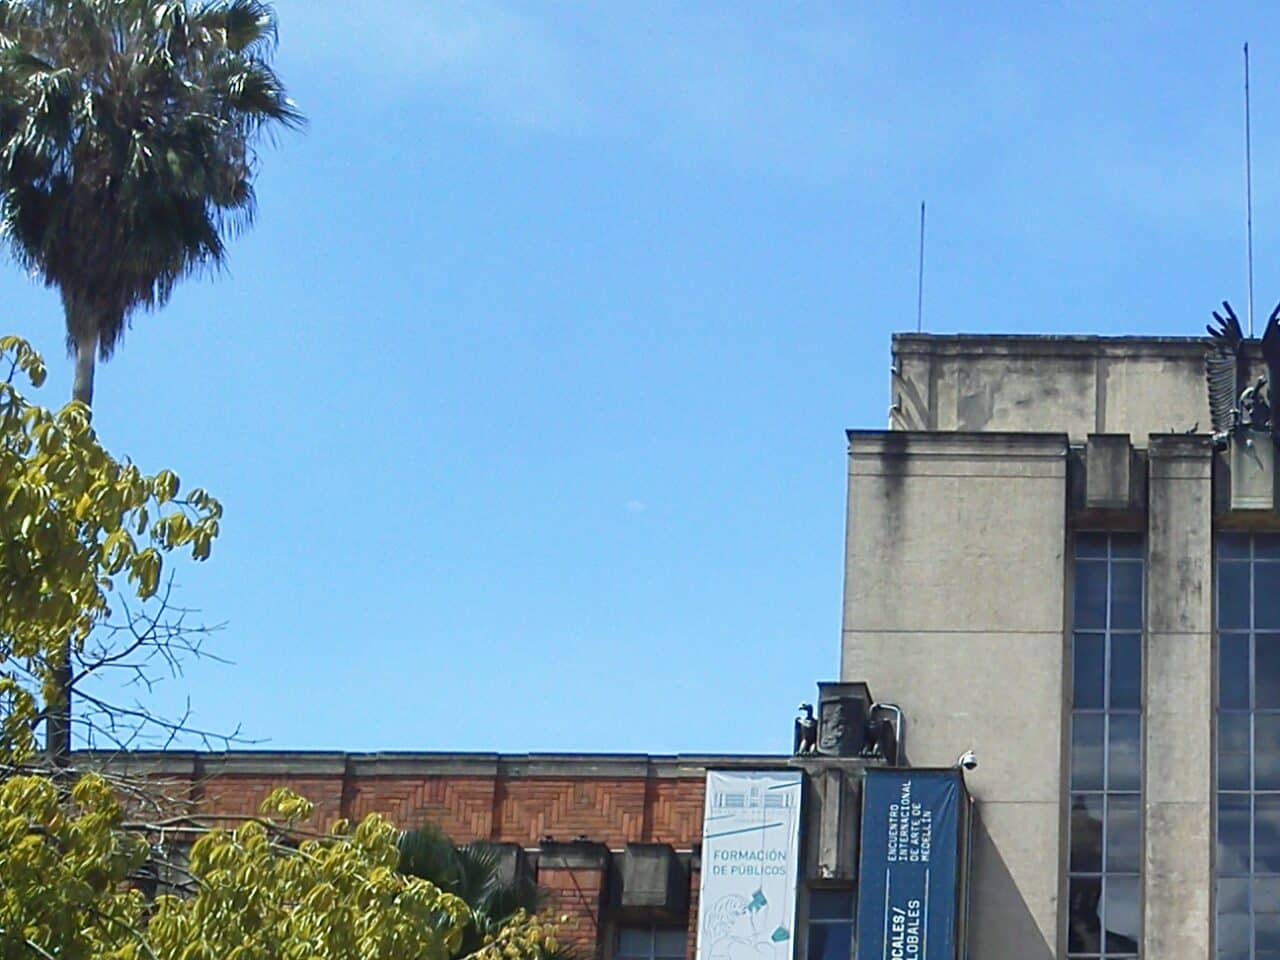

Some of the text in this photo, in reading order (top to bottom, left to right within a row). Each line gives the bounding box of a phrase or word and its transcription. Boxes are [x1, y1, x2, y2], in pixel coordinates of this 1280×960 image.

[888, 804, 899, 861] ENCUENTRO
[899, 779, 911, 861] INTERNACIONAL
[910, 802, 921, 861] DE ARTE DE
[713, 848, 786, 861] FORMACIÓN
[713, 865, 727, 876] DE
